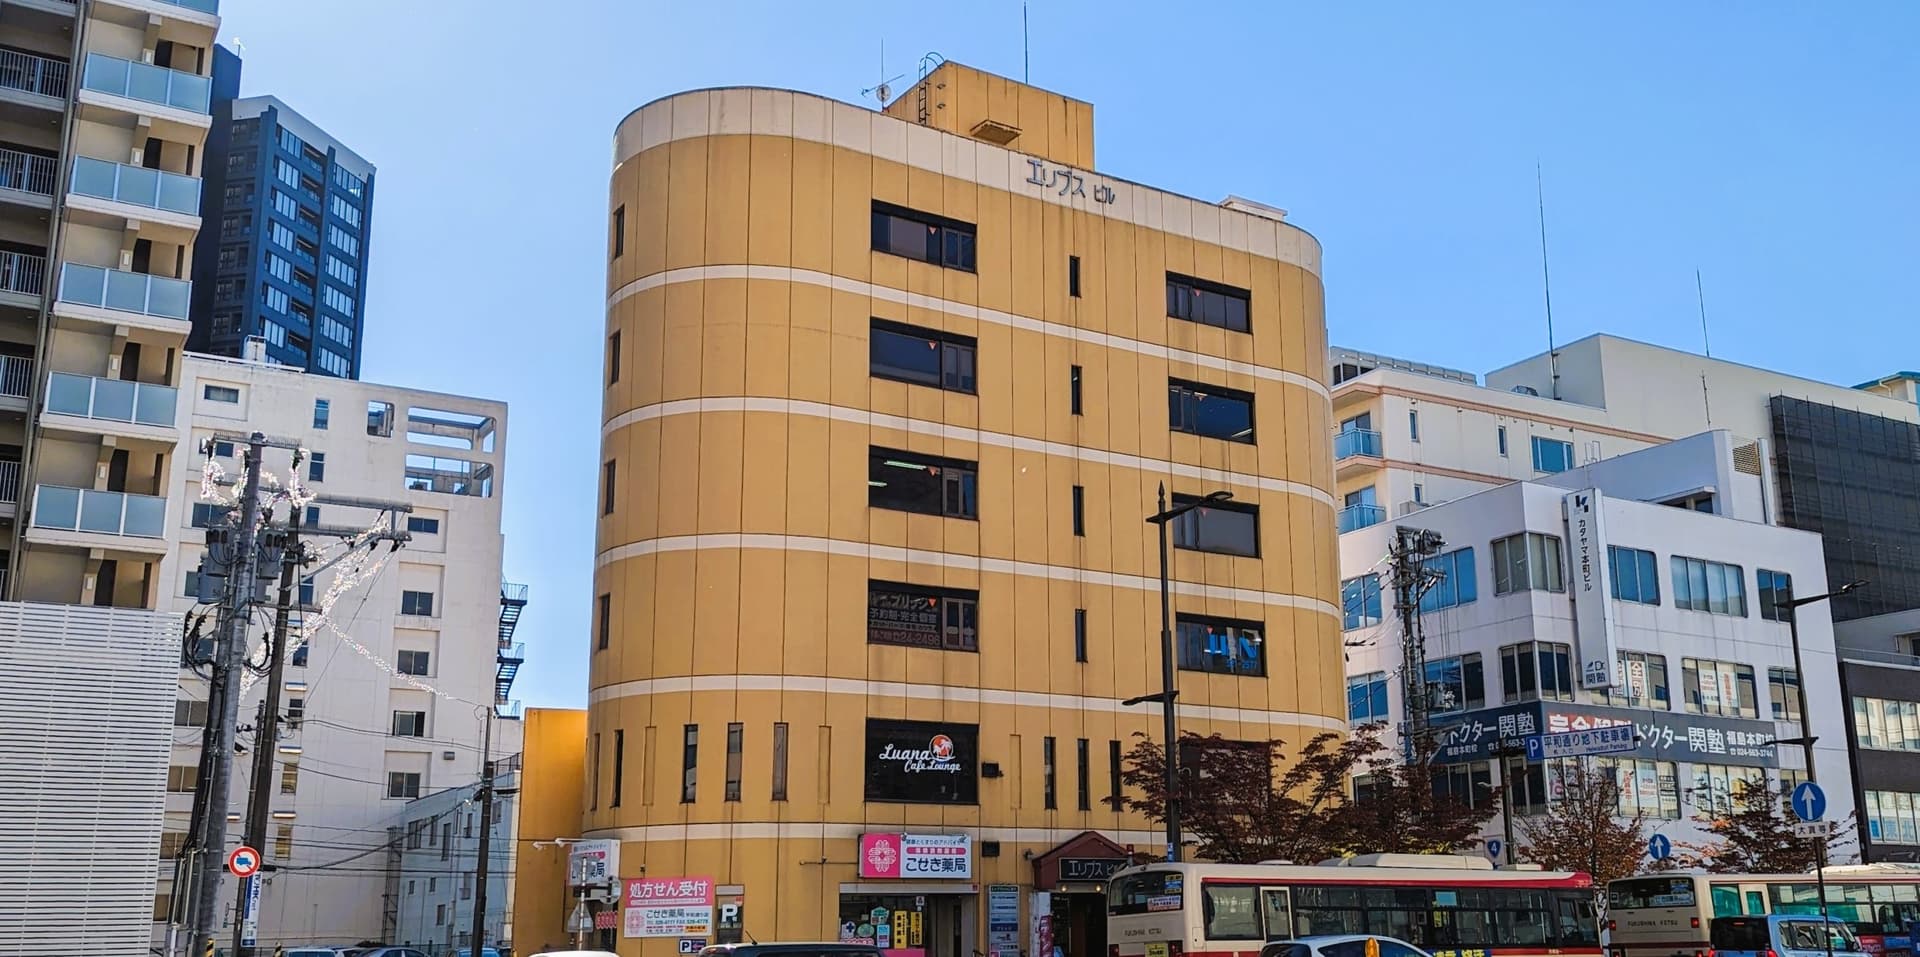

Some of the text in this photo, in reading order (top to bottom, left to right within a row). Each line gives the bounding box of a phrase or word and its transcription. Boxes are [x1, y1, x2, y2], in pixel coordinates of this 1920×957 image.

[1094, 184, 1116, 205] ビル
[1578, 519, 1593, 592] カタヤマ本町ビル
[1586, 672, 1606, 685] 関塾
[1544, 727, 1630, 748] 平和通り地下駐車場
[1635, 722, 1727, 754] ドクター関塾
[1726, 730, 1777, 748] 福島本町校
[879, 743, 931, 761] Luana
[1529, 738, 1539, 757] P
[904, 758, 961, 774] Cafe Lounge
[1490, 842, 1497, 854] 4
[906, 857, 966, 872] こせき薬局
[1068, 860, 1103, 878] エリプス
[629, 880, 708, 898] 処方せん受付
[721, 904, 738, 923] P
[681, 941, 690, 951] P
